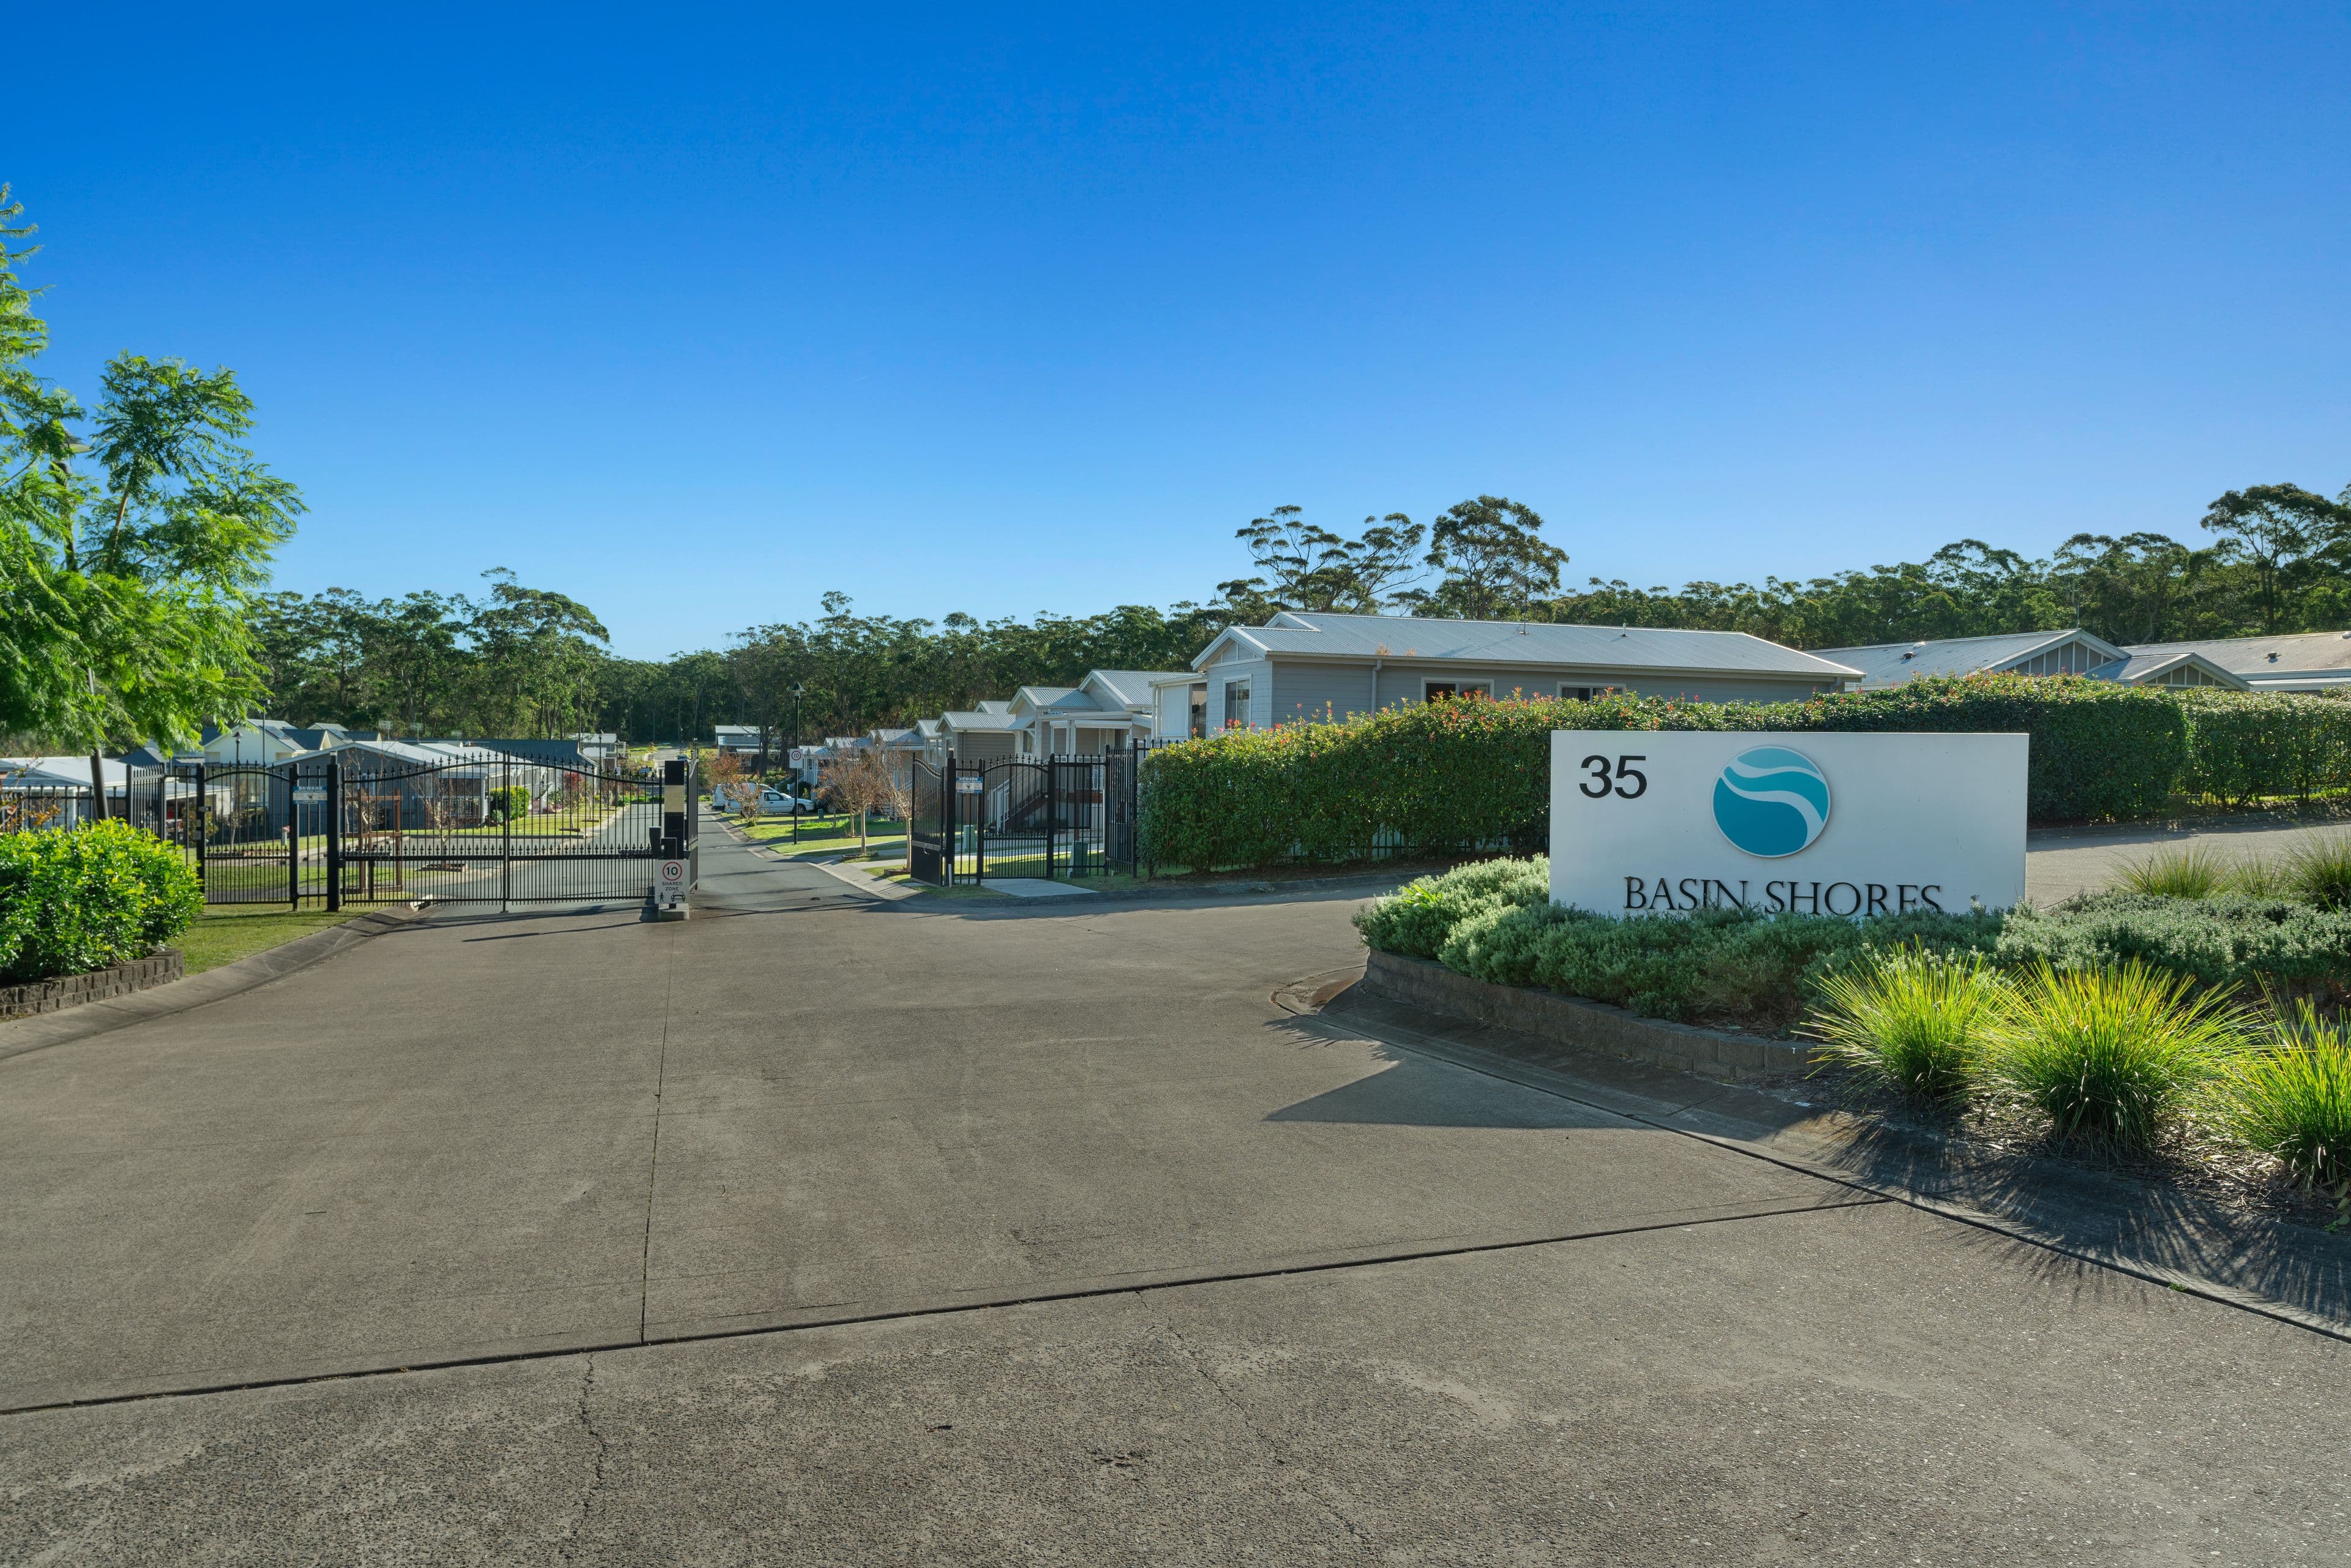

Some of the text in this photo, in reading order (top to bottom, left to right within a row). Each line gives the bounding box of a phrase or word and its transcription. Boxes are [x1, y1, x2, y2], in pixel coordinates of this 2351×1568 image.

[1579, 755, 1647, 799] 35
[667, 866, 678, 876] 10
[1624, 876, 1748, 911] BASIN
